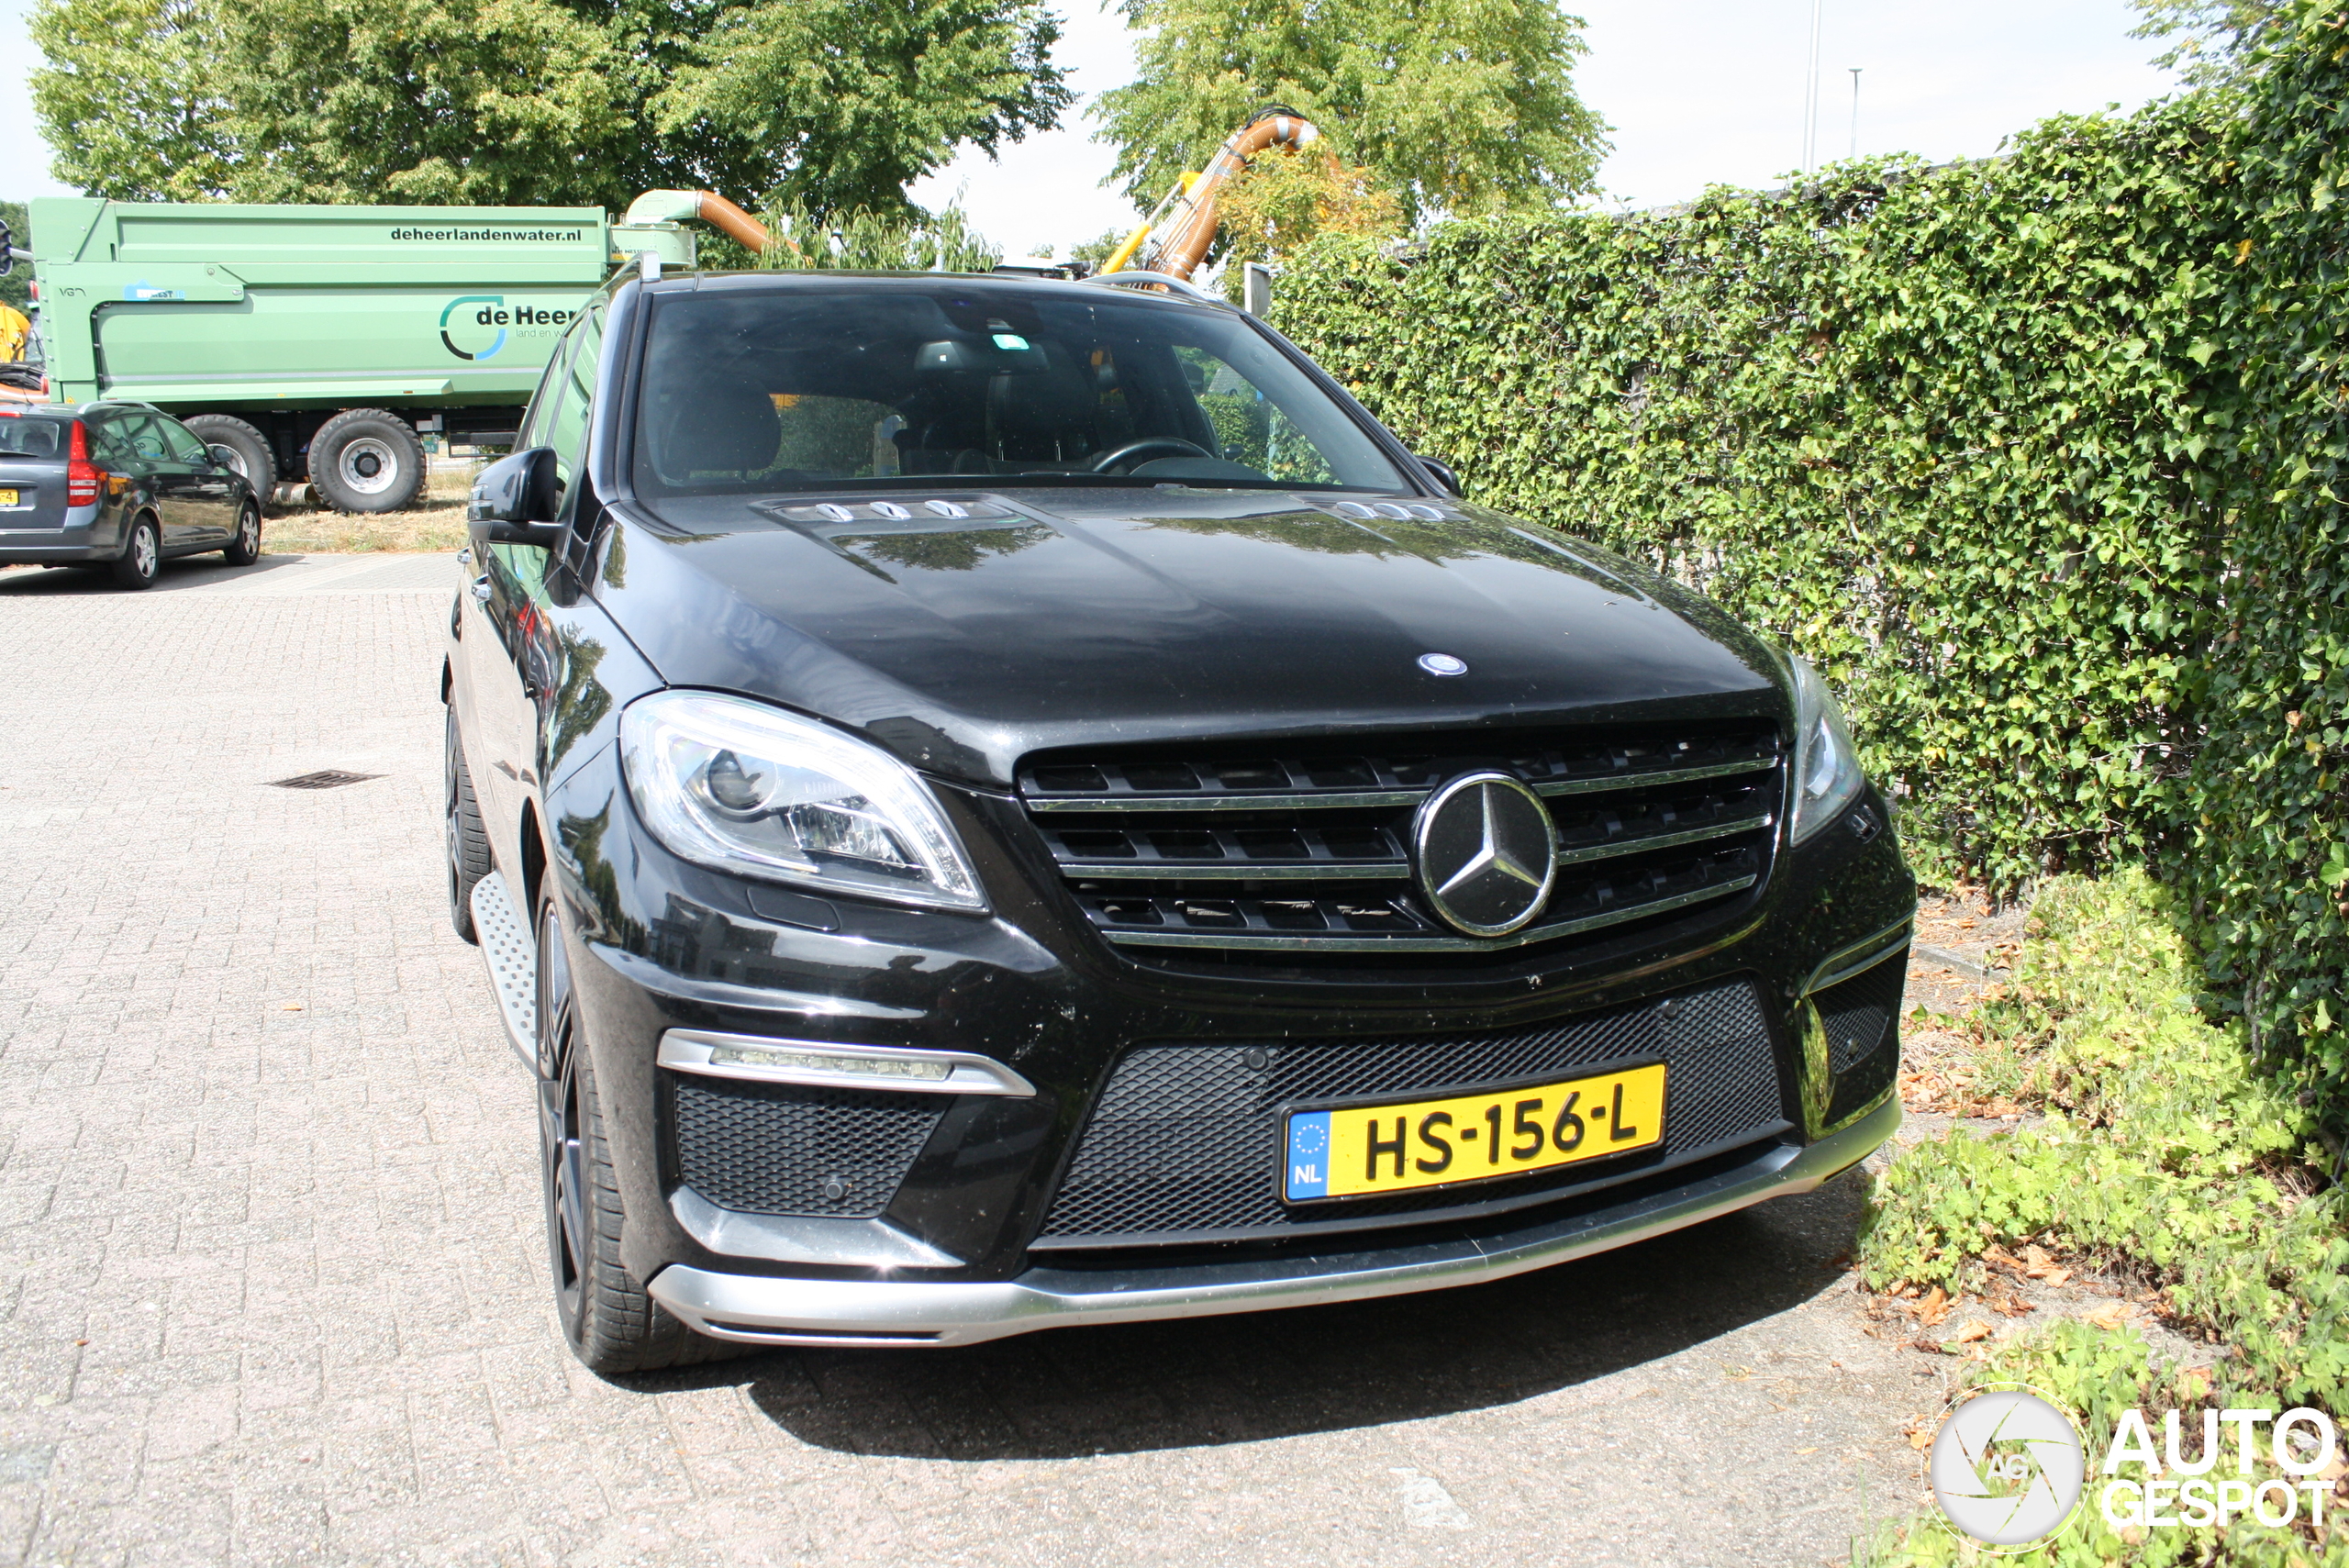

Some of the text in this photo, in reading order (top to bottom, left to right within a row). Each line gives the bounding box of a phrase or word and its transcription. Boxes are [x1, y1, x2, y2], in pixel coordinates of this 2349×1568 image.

[391, 228, 582, 241] deheerlandenwater.nl
[476, 306, 508, 325] de
[516, 328, 537, 338] land
[1365, 1083, 1637, 1181] HS-156-L
[1295, 1164, 1322, 1184] NL
